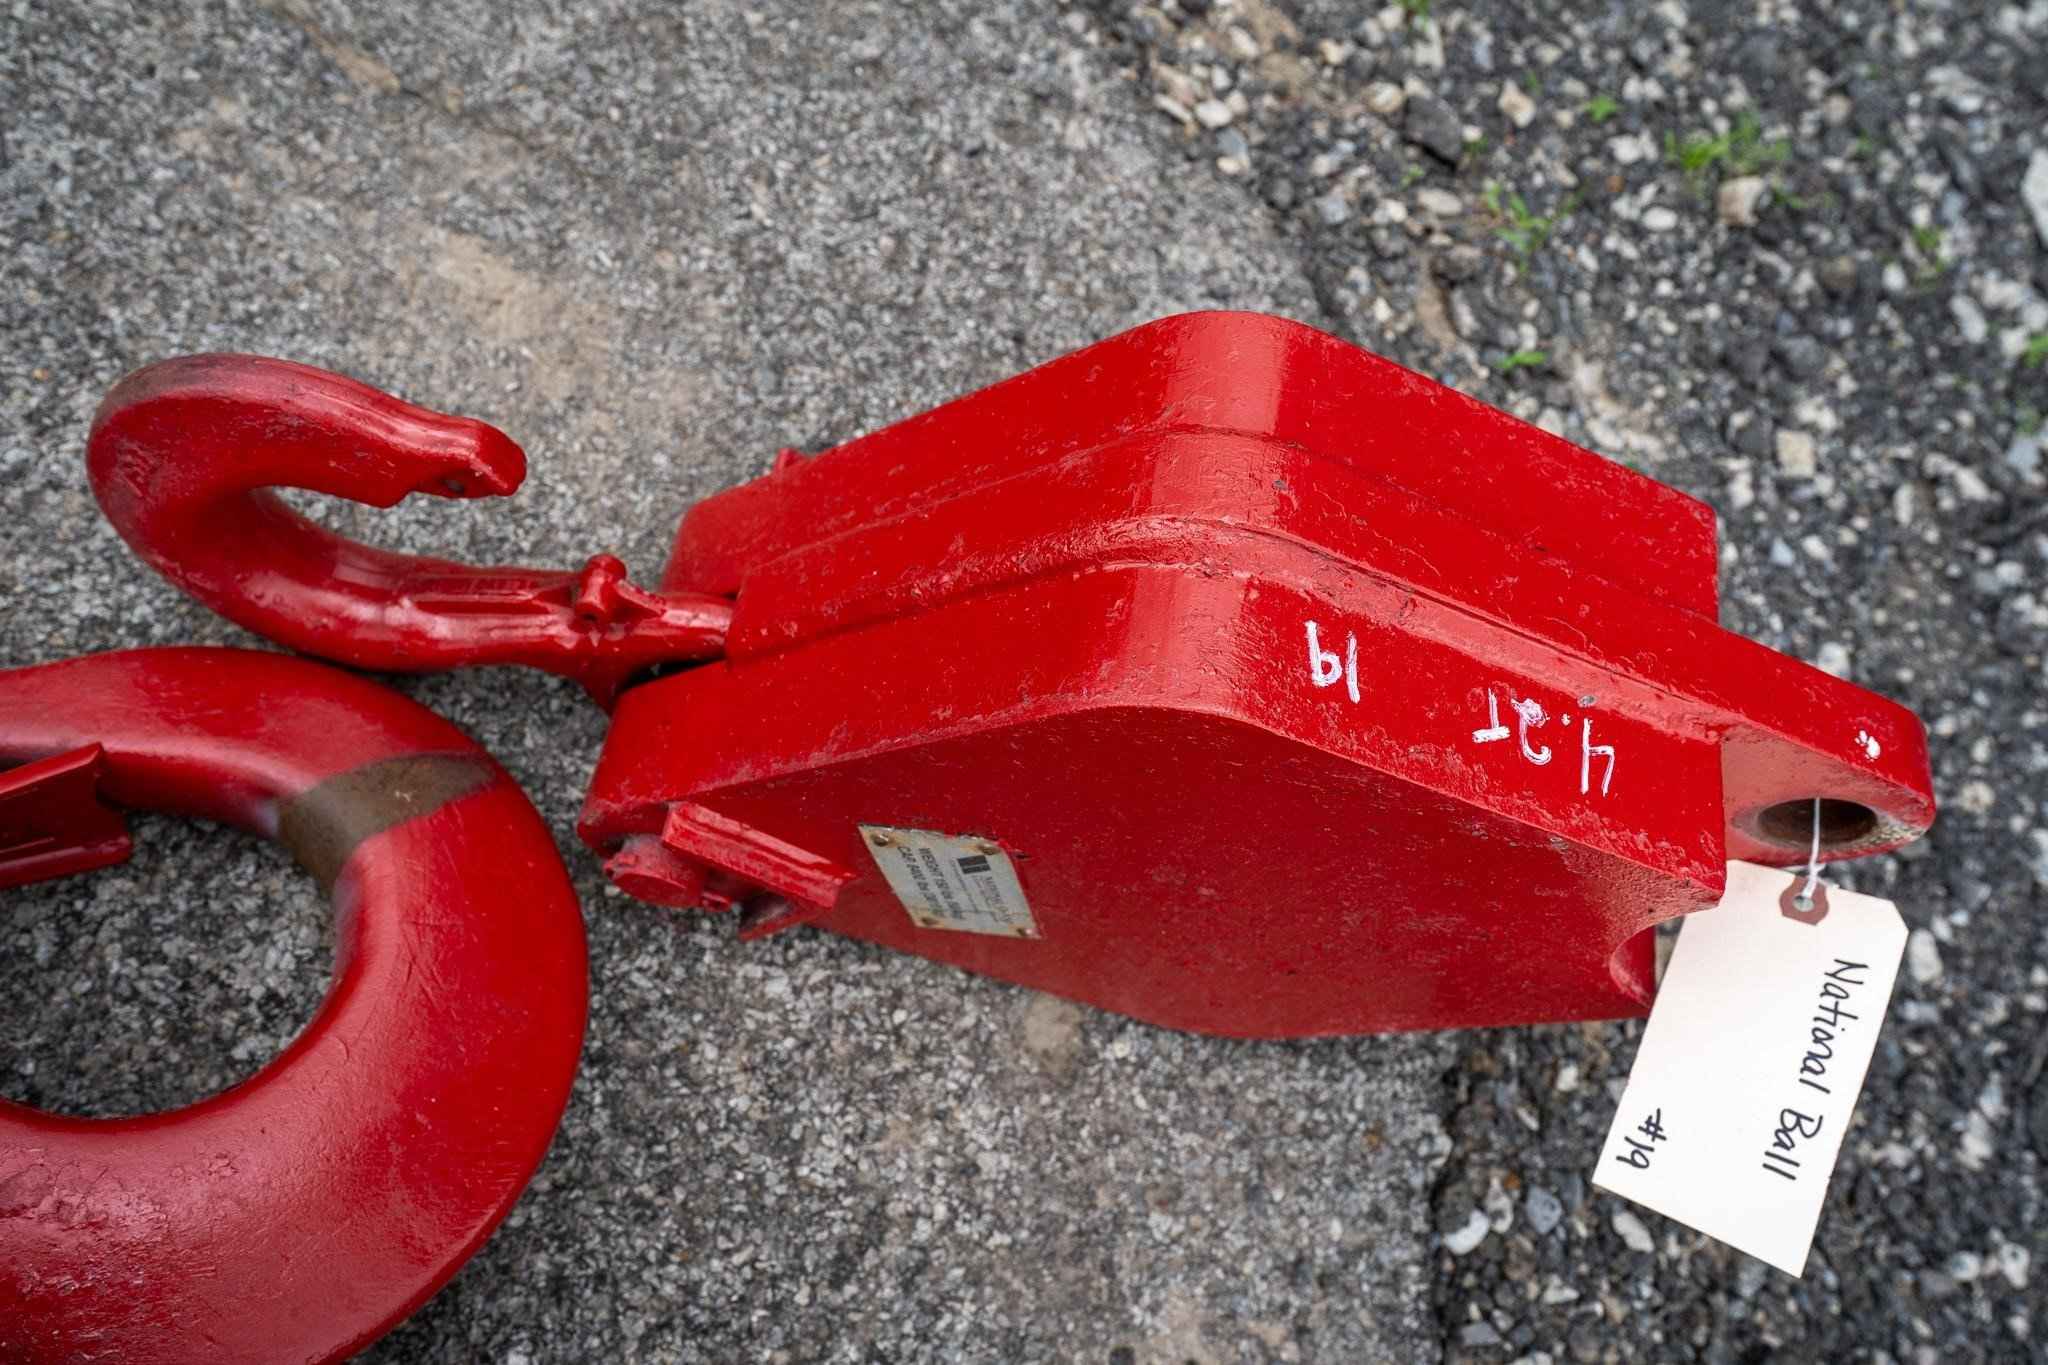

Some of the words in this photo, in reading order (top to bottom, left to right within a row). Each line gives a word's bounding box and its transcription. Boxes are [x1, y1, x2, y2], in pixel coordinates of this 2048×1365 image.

[1798, 959, 1868, 1095] National
[1615, 1107, 1667, 1170] #19
[1762, 1108, 1824, 1181] Ball
